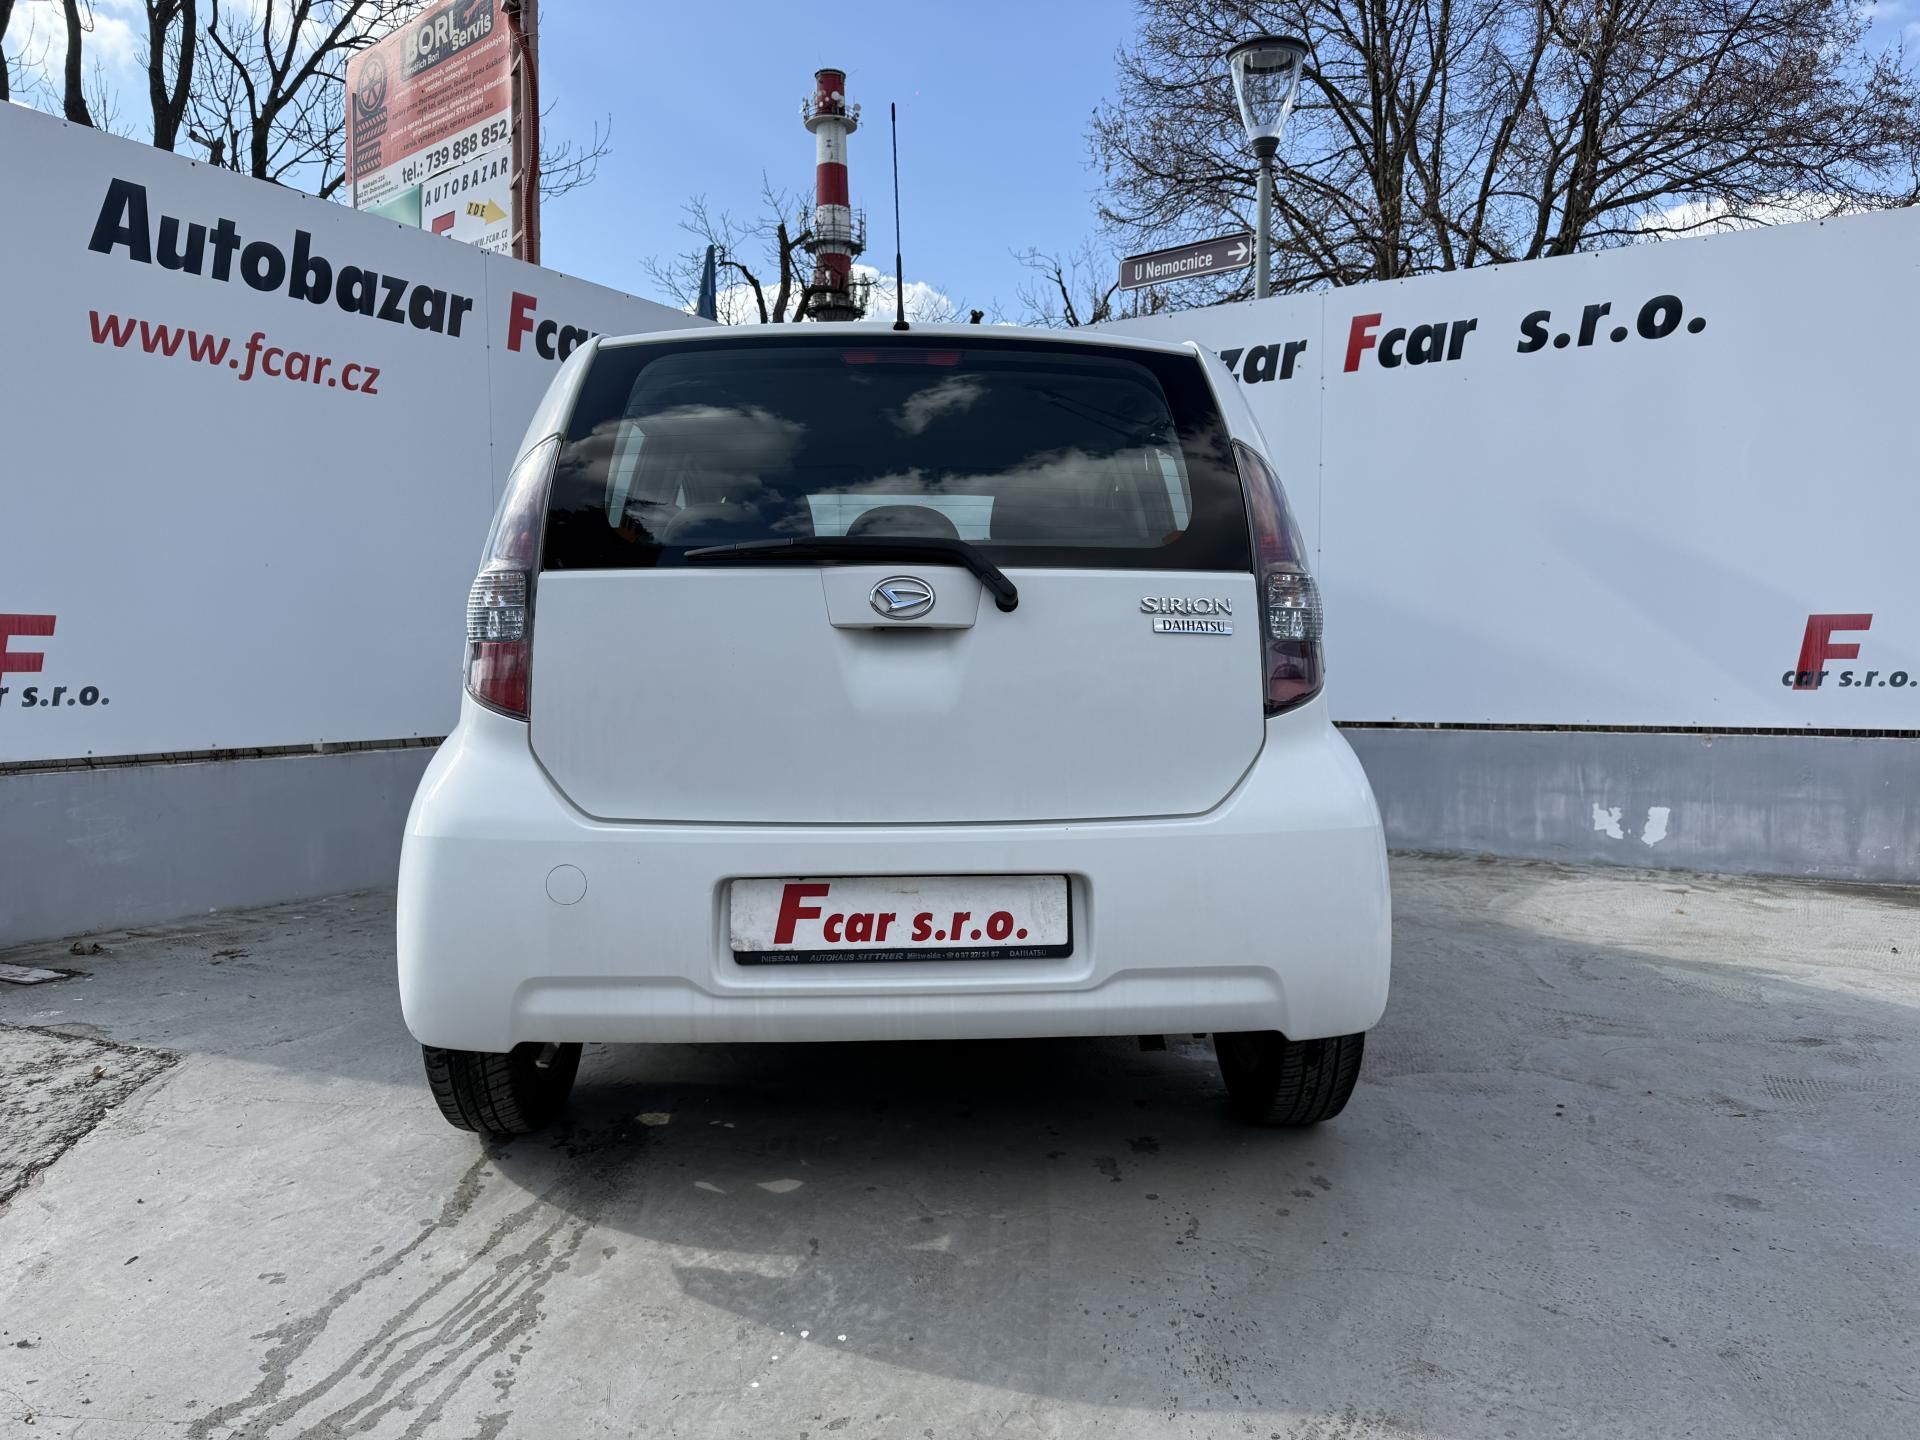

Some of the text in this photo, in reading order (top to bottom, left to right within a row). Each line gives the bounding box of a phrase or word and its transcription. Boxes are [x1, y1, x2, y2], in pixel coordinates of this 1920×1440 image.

[405, 10, 460, 64] BORL
[452, 14, 492, 51] servis
[402, 119, 507, 184] tel.: 739 888 852
[424, 156, 508, 207] AUTOBAZAR
[467, 202, 486, 217] ZDE
[87, 177, 600, 363] Autobazar Fca
[1134, 252, 1213, 281] U Nemocnice
[1343, 312, 1478, 373] Fcar
[1516, 294, 1707, 353] s.r.o.
[88, 309, 381, 395] www.fcar.cz
[1140, 596, 1232, 616] SIRION
[1162, 619, 1226, 632] DAIHATSU
[1838, 670, 1918, 687] s.r.o.
[21, 685, 110, 708] s.r.o.
[911, 910, 1028, 941] s.r.o.
[761, 955, 799, 963] NISSAN
[808, 952, 855, 962] AUTOHAUS
[1009, 949, 1047, 957] DAIHATSU
